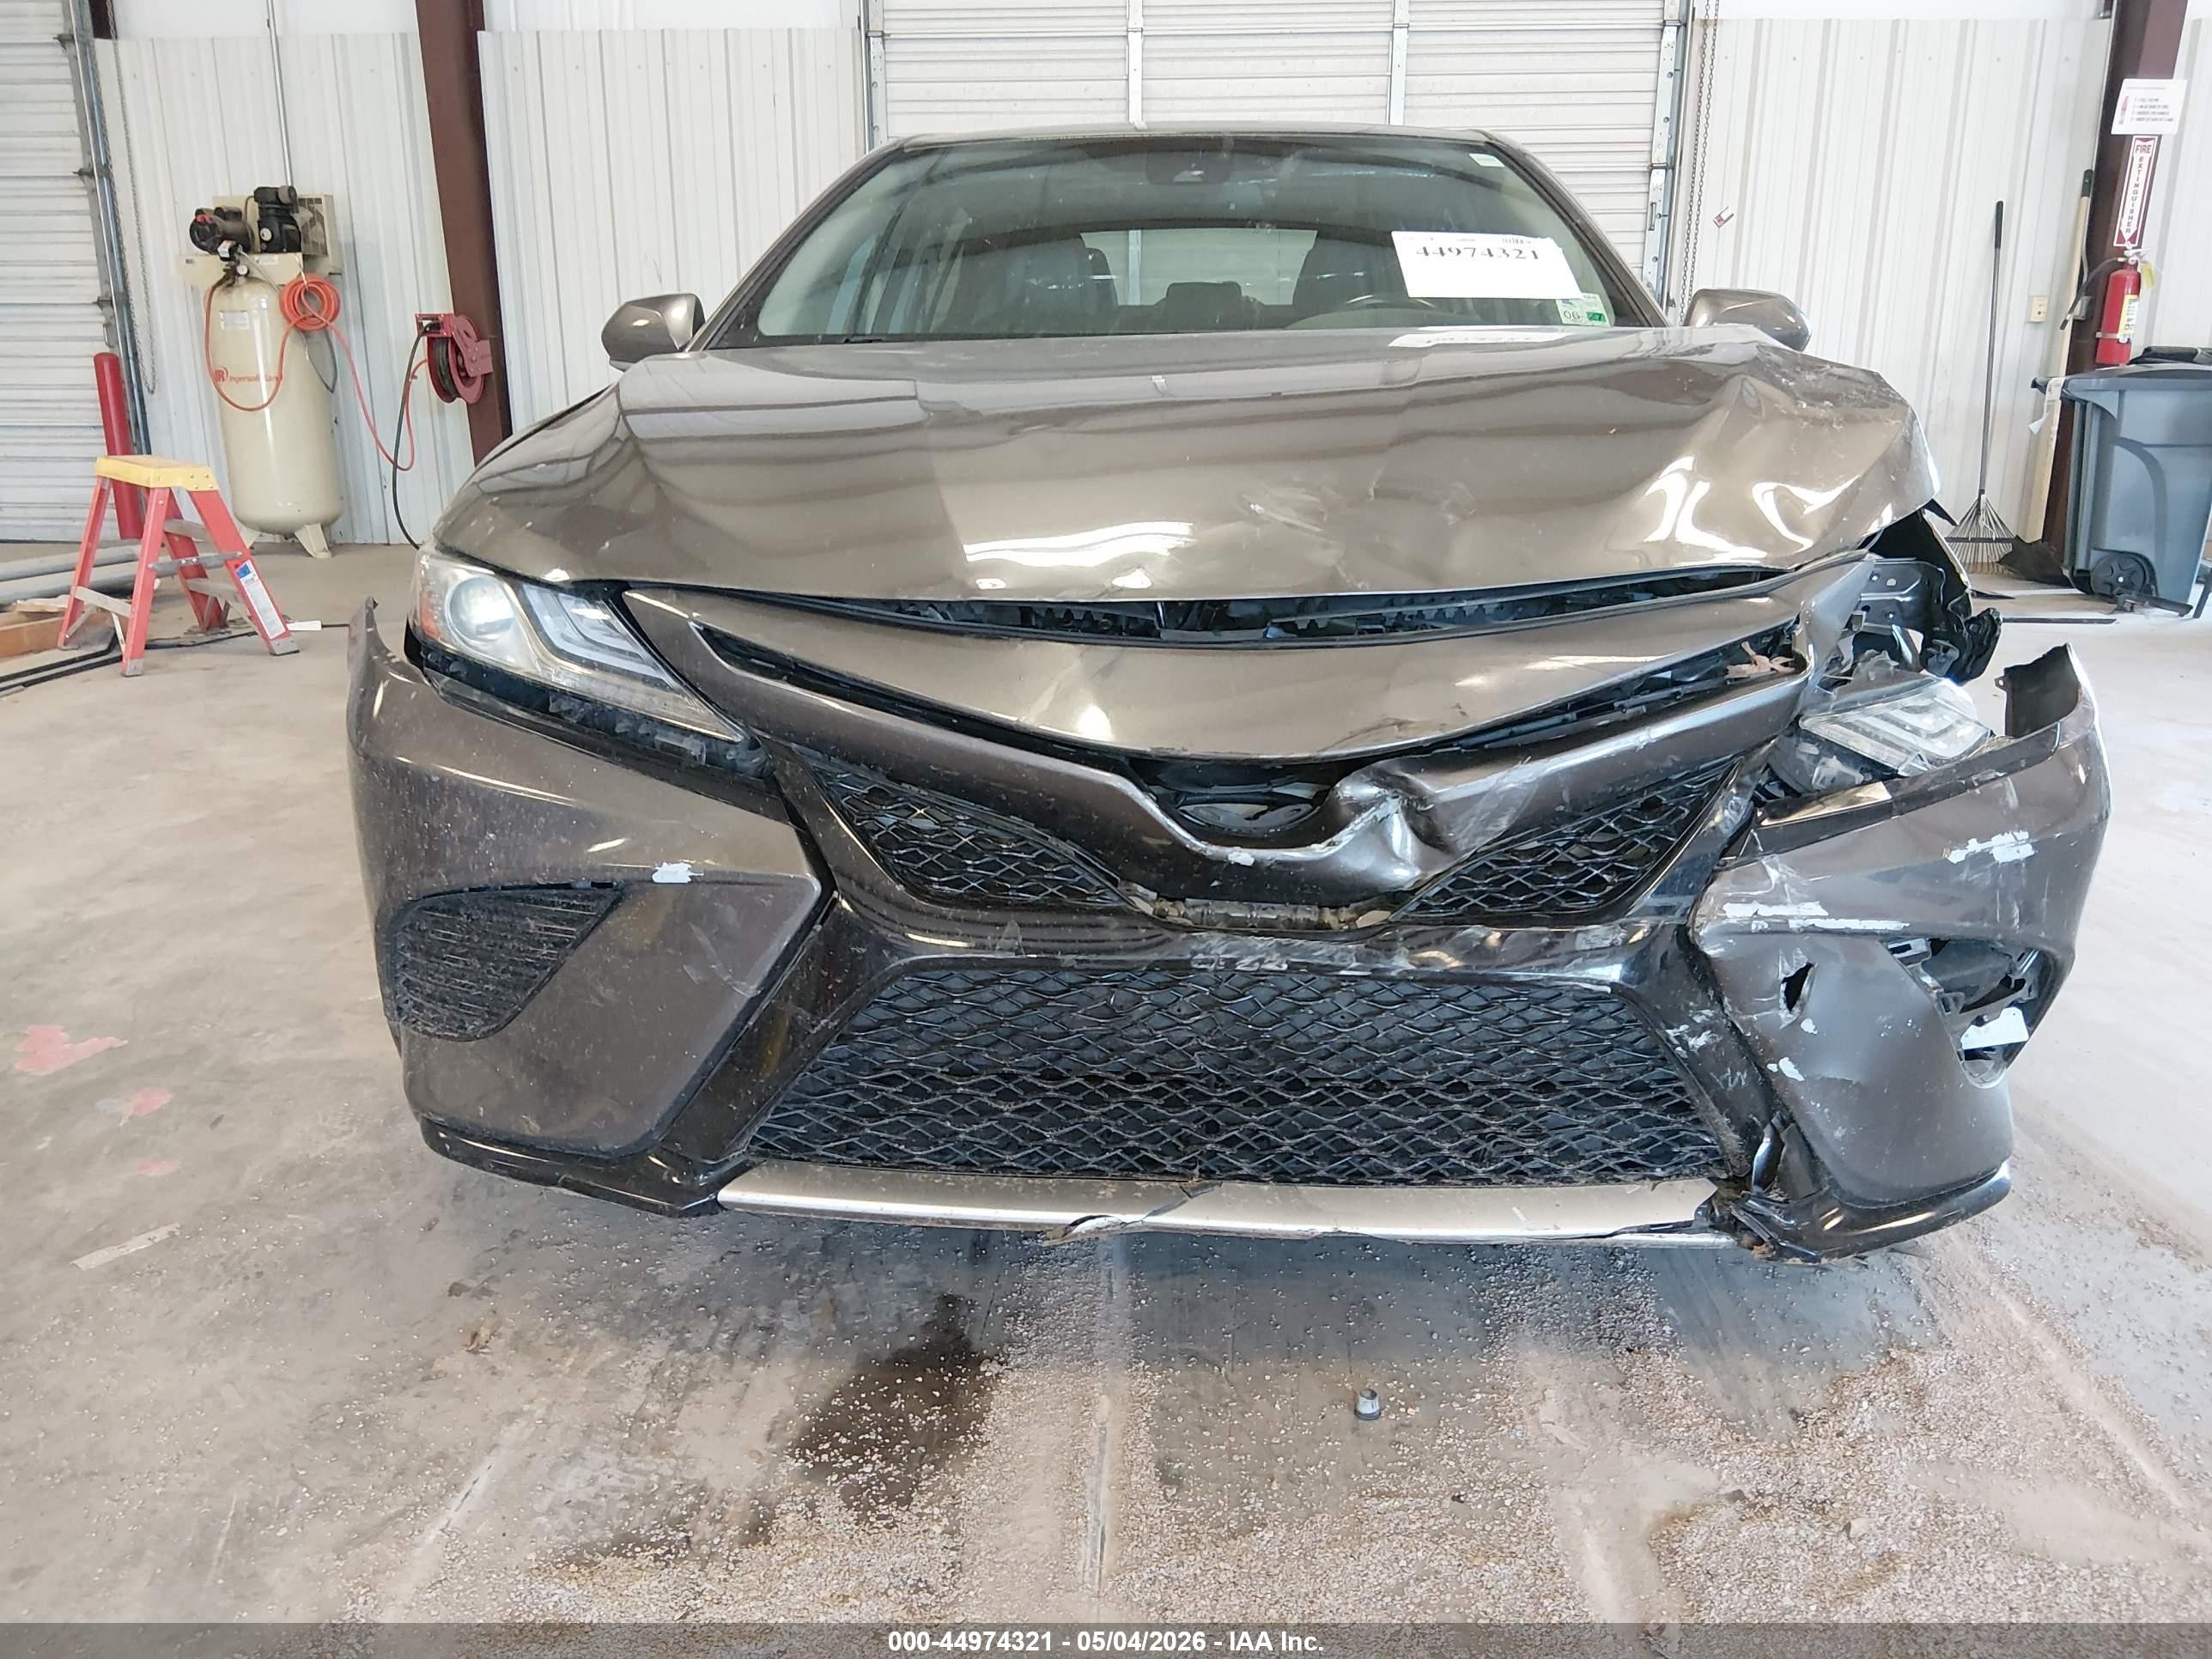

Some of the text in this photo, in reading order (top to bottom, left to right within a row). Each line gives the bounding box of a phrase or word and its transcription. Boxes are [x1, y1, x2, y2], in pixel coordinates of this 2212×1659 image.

[2136, 144, 2152, 154] FIRE
[2125, 156, 2144, 234] EXTINGUISHER
[1416, 246, 1540, 259] 44974321
